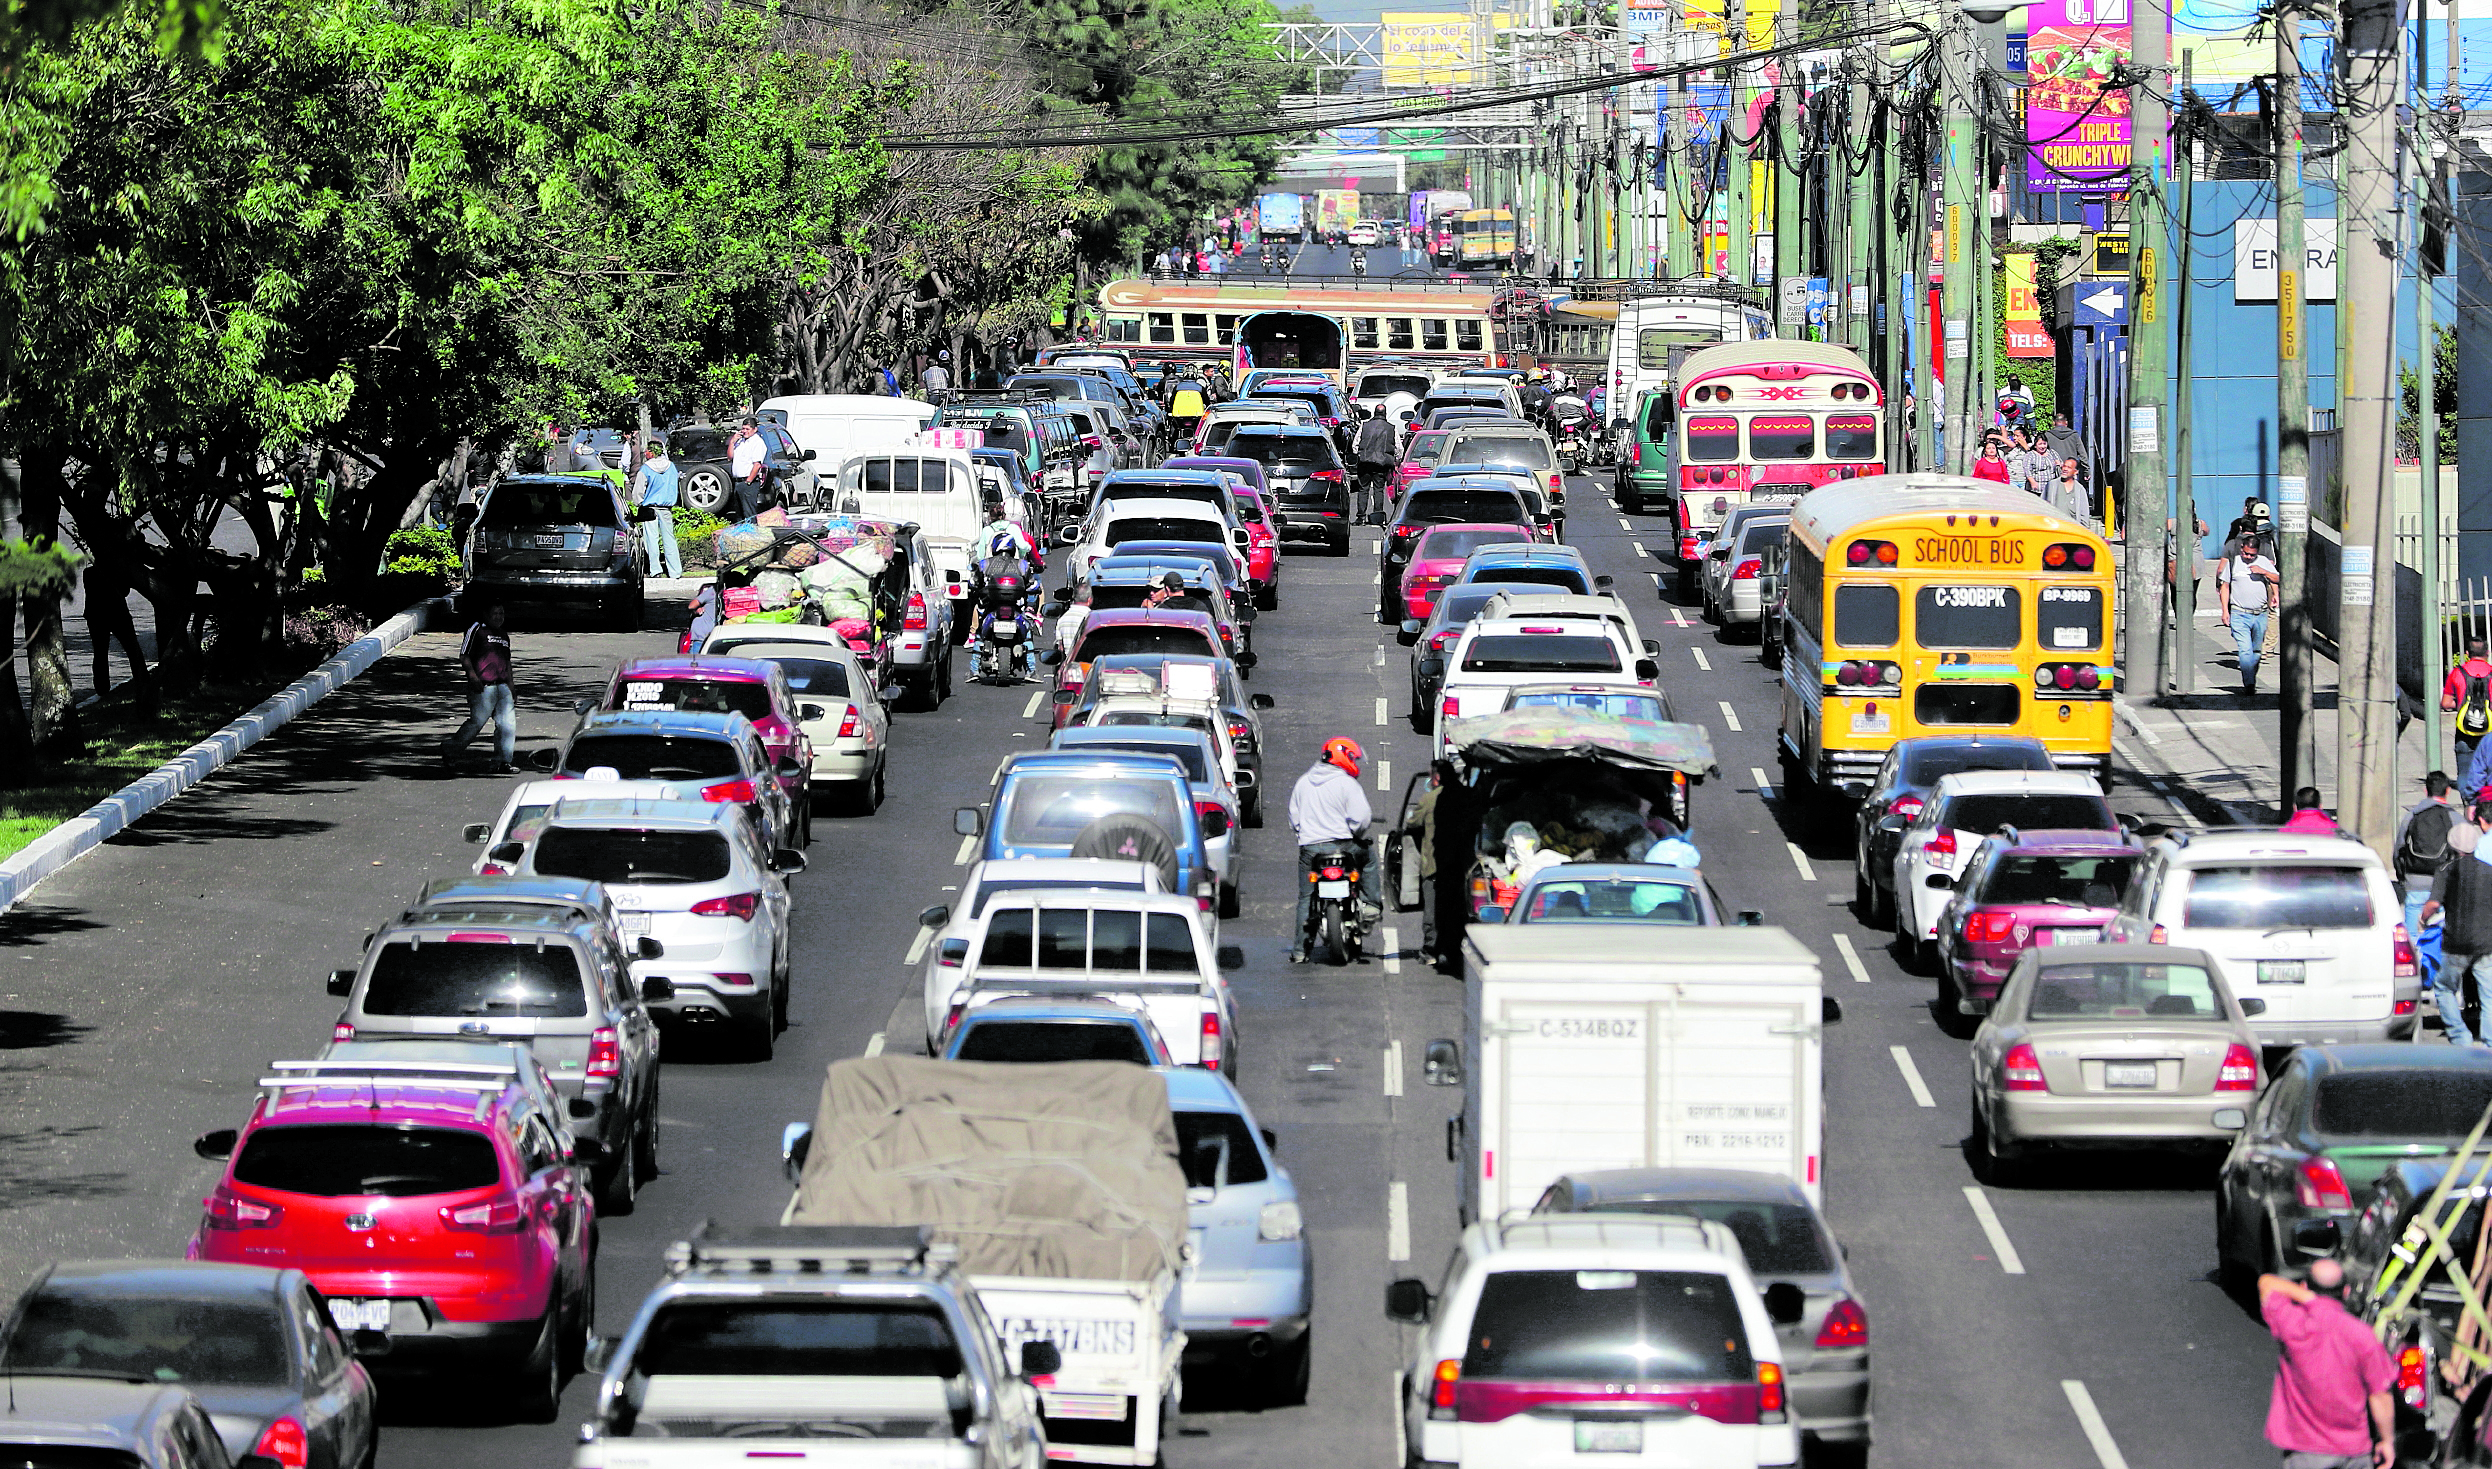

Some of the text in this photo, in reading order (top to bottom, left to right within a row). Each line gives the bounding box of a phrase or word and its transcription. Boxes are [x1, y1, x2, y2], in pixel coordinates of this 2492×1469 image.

[2079, 122, 2121, 141] TRIPLE
[2009, 333, 2047, 348] TELS:
[1915, 538, 2024, 564] SCHOOL BUS
[1935, 587, 2006, 608] C-390BPK
[2043, 589, 2091, 602] BP-9969
[626, 682, 664, 693] VENDO
